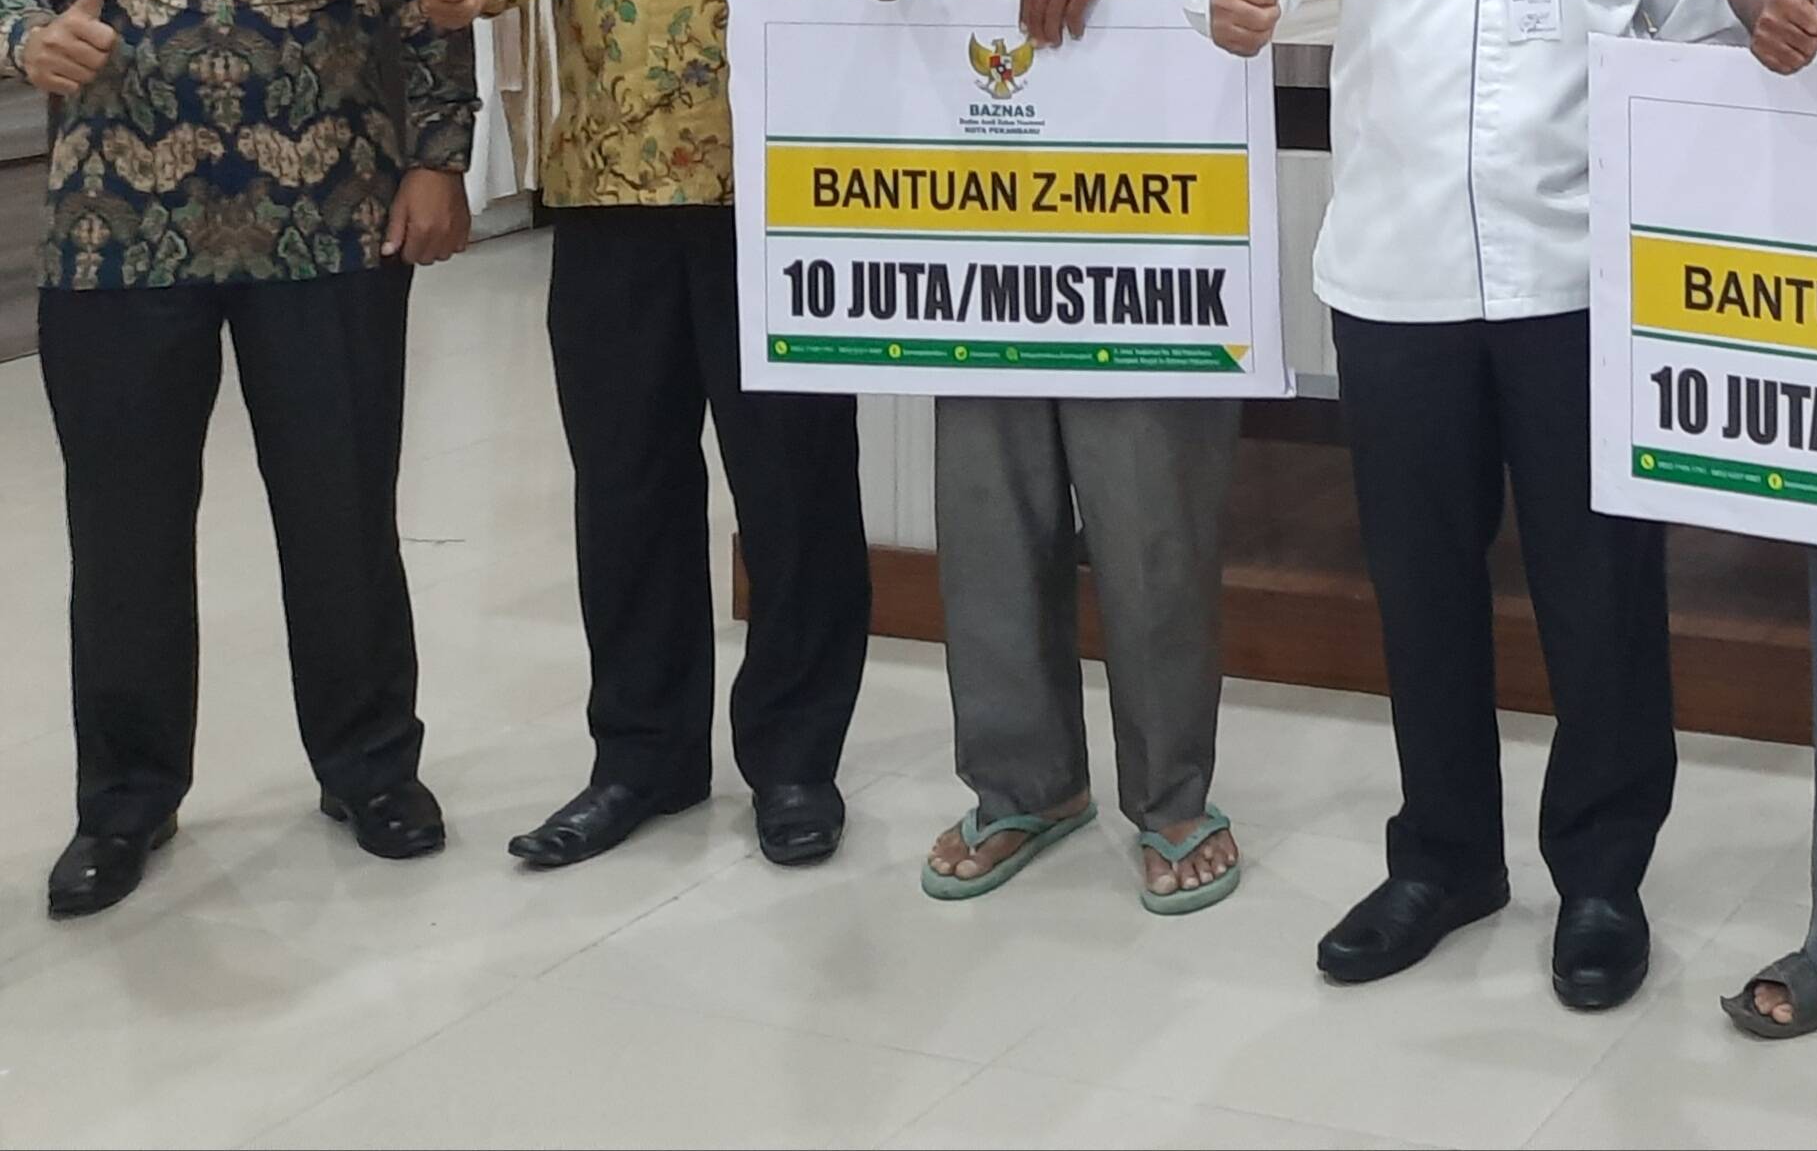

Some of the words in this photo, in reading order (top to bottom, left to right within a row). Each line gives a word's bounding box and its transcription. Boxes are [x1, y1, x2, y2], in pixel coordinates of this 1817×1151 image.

[969, 103, 1036, 118] BAZNAS
[813, 167, 1017, 212] BANTUAN
[1031, 172, 1198, 214] Z-MART
[783, 259, 836, 318] 10
[847, 261, 1229, 328] JUTA/MUSTAHIK
[1650, 366, 1708, 435] 10
